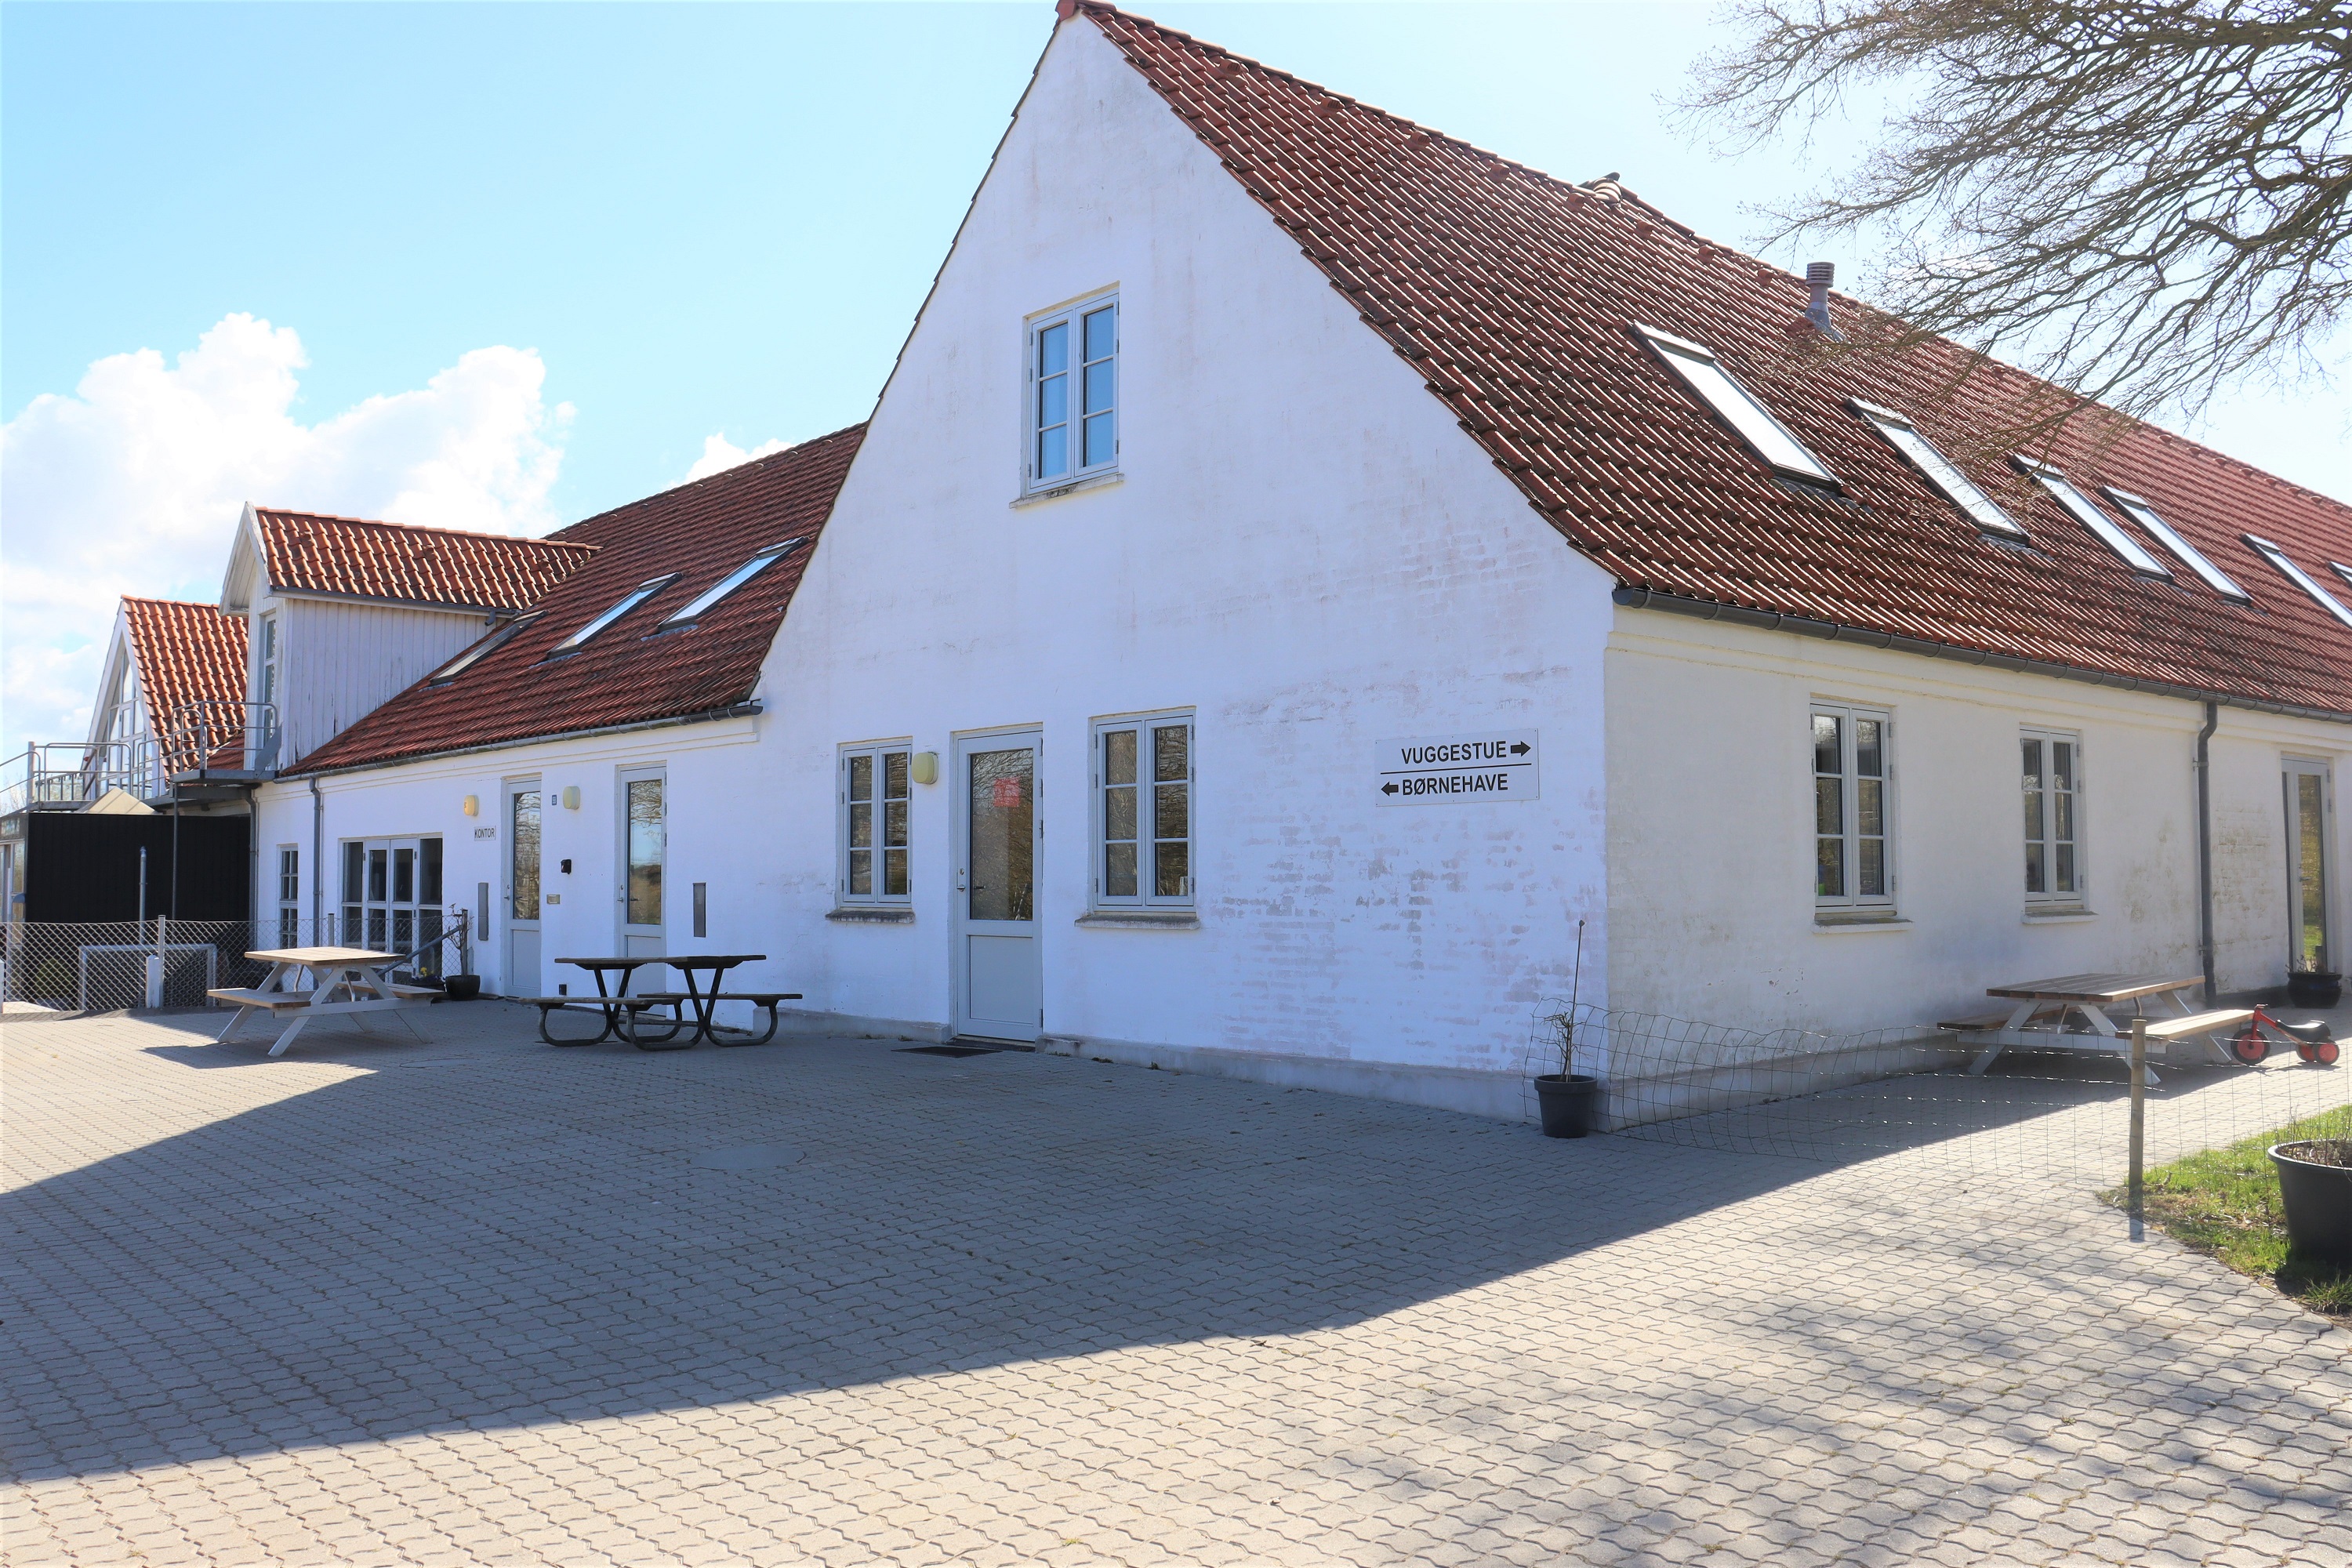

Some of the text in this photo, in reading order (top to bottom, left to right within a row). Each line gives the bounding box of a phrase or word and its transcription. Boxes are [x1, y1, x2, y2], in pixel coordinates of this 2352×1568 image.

[1401, 740, 1507, 764] VUGGESTUE
[1403, 773, 1508, 796] BØRNEHAVE
[474, 828, 495, 838] KONTOR
